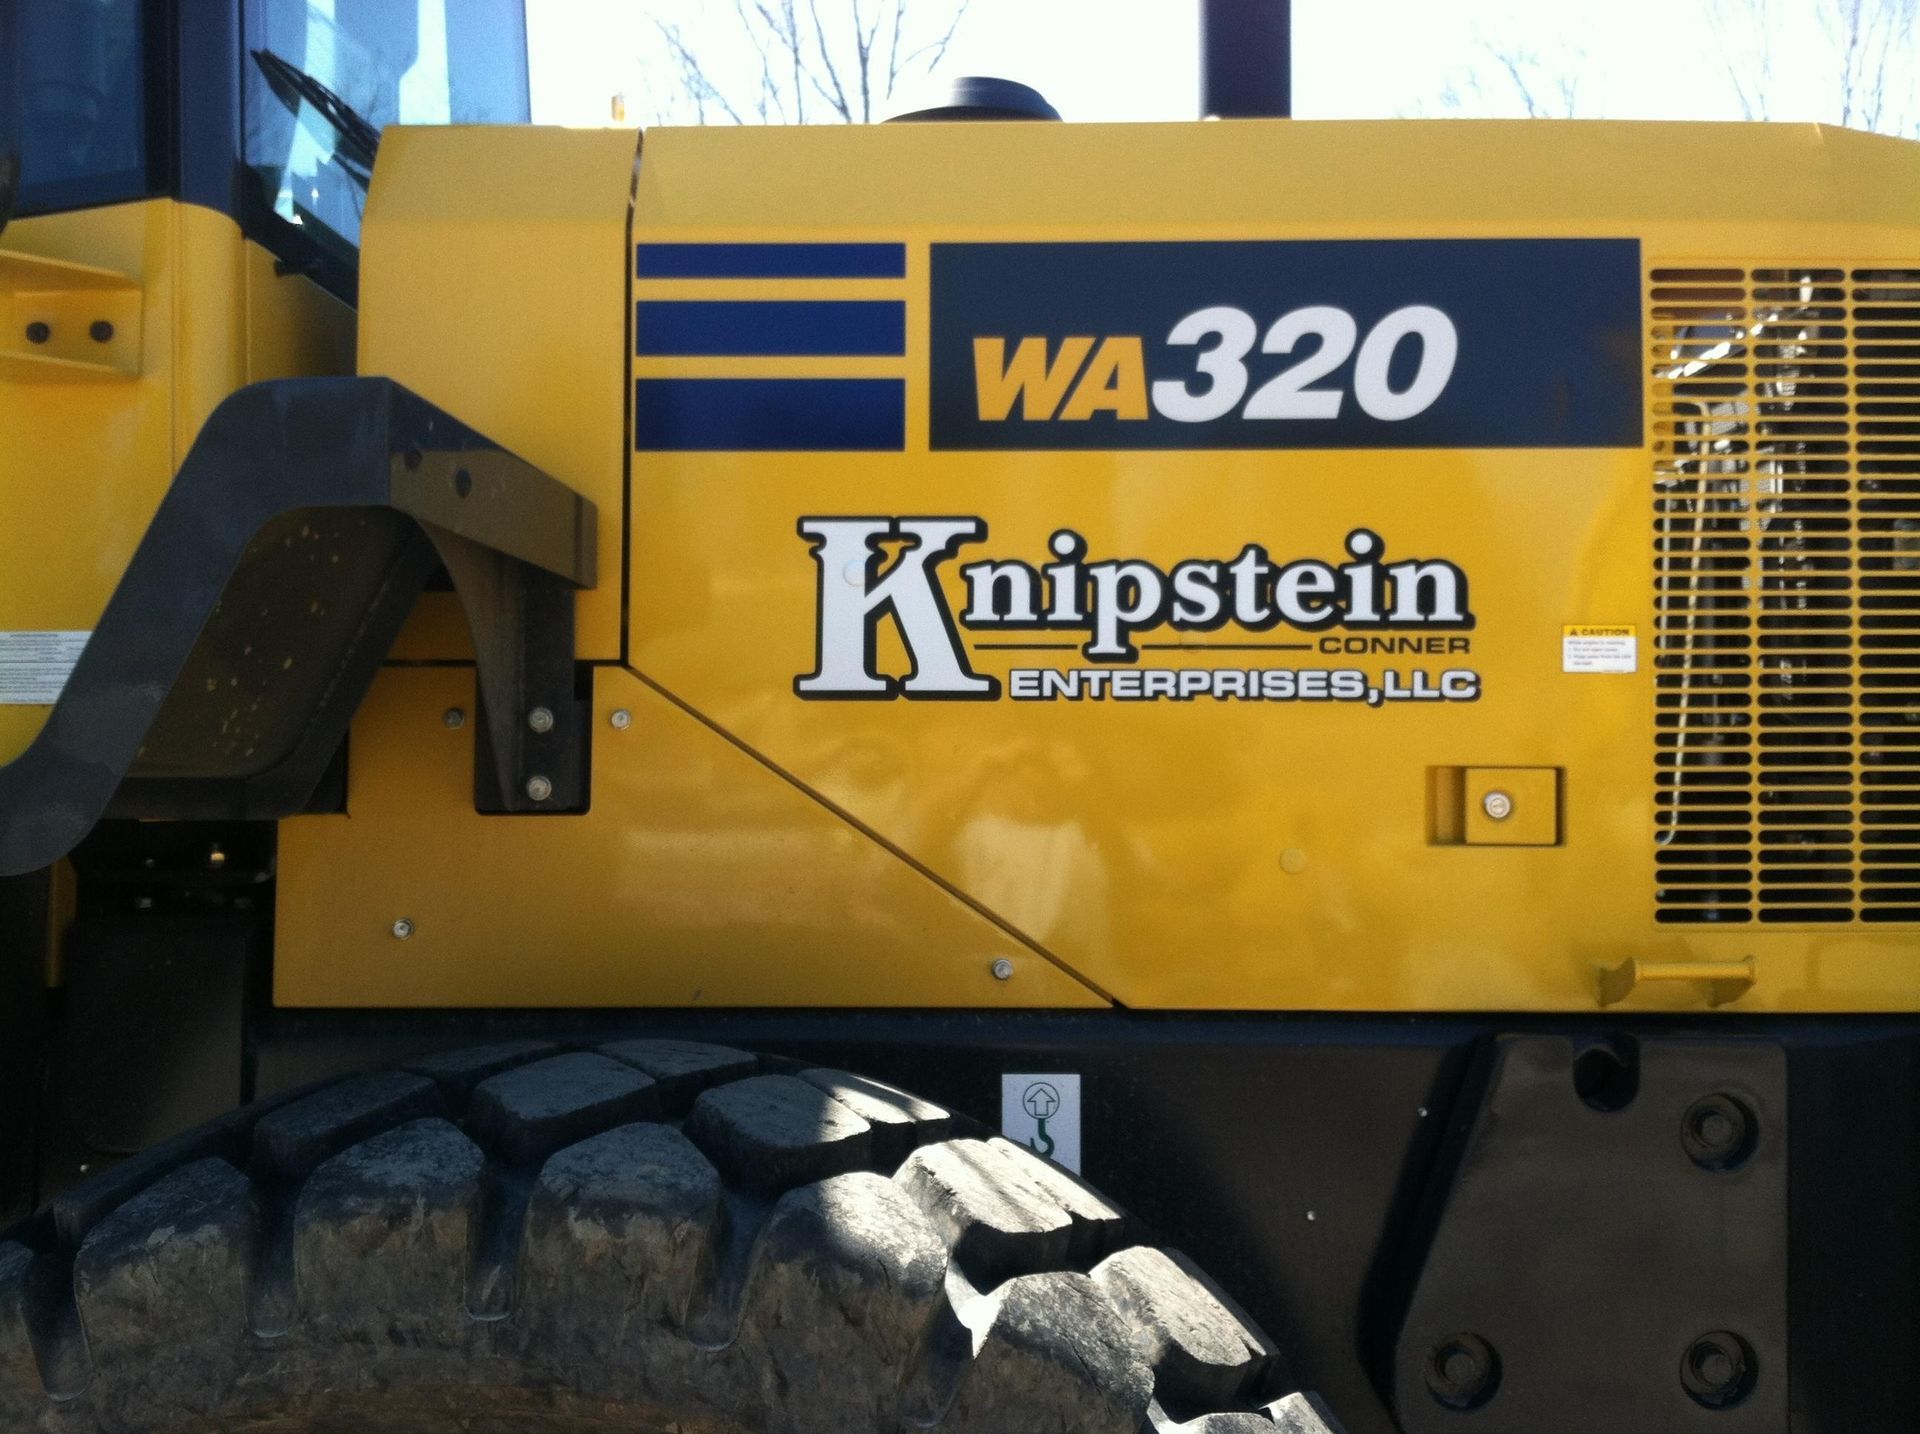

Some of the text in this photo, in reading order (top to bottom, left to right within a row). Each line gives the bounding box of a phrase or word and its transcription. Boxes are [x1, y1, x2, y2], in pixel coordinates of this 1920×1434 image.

[973, 305, 1458, 422] WA320
[798, 517, 1475, 699] Knipstein
[1581, 628, 1630, 637] CAUTION
[1318, 637, 1471, 655] CONNER
